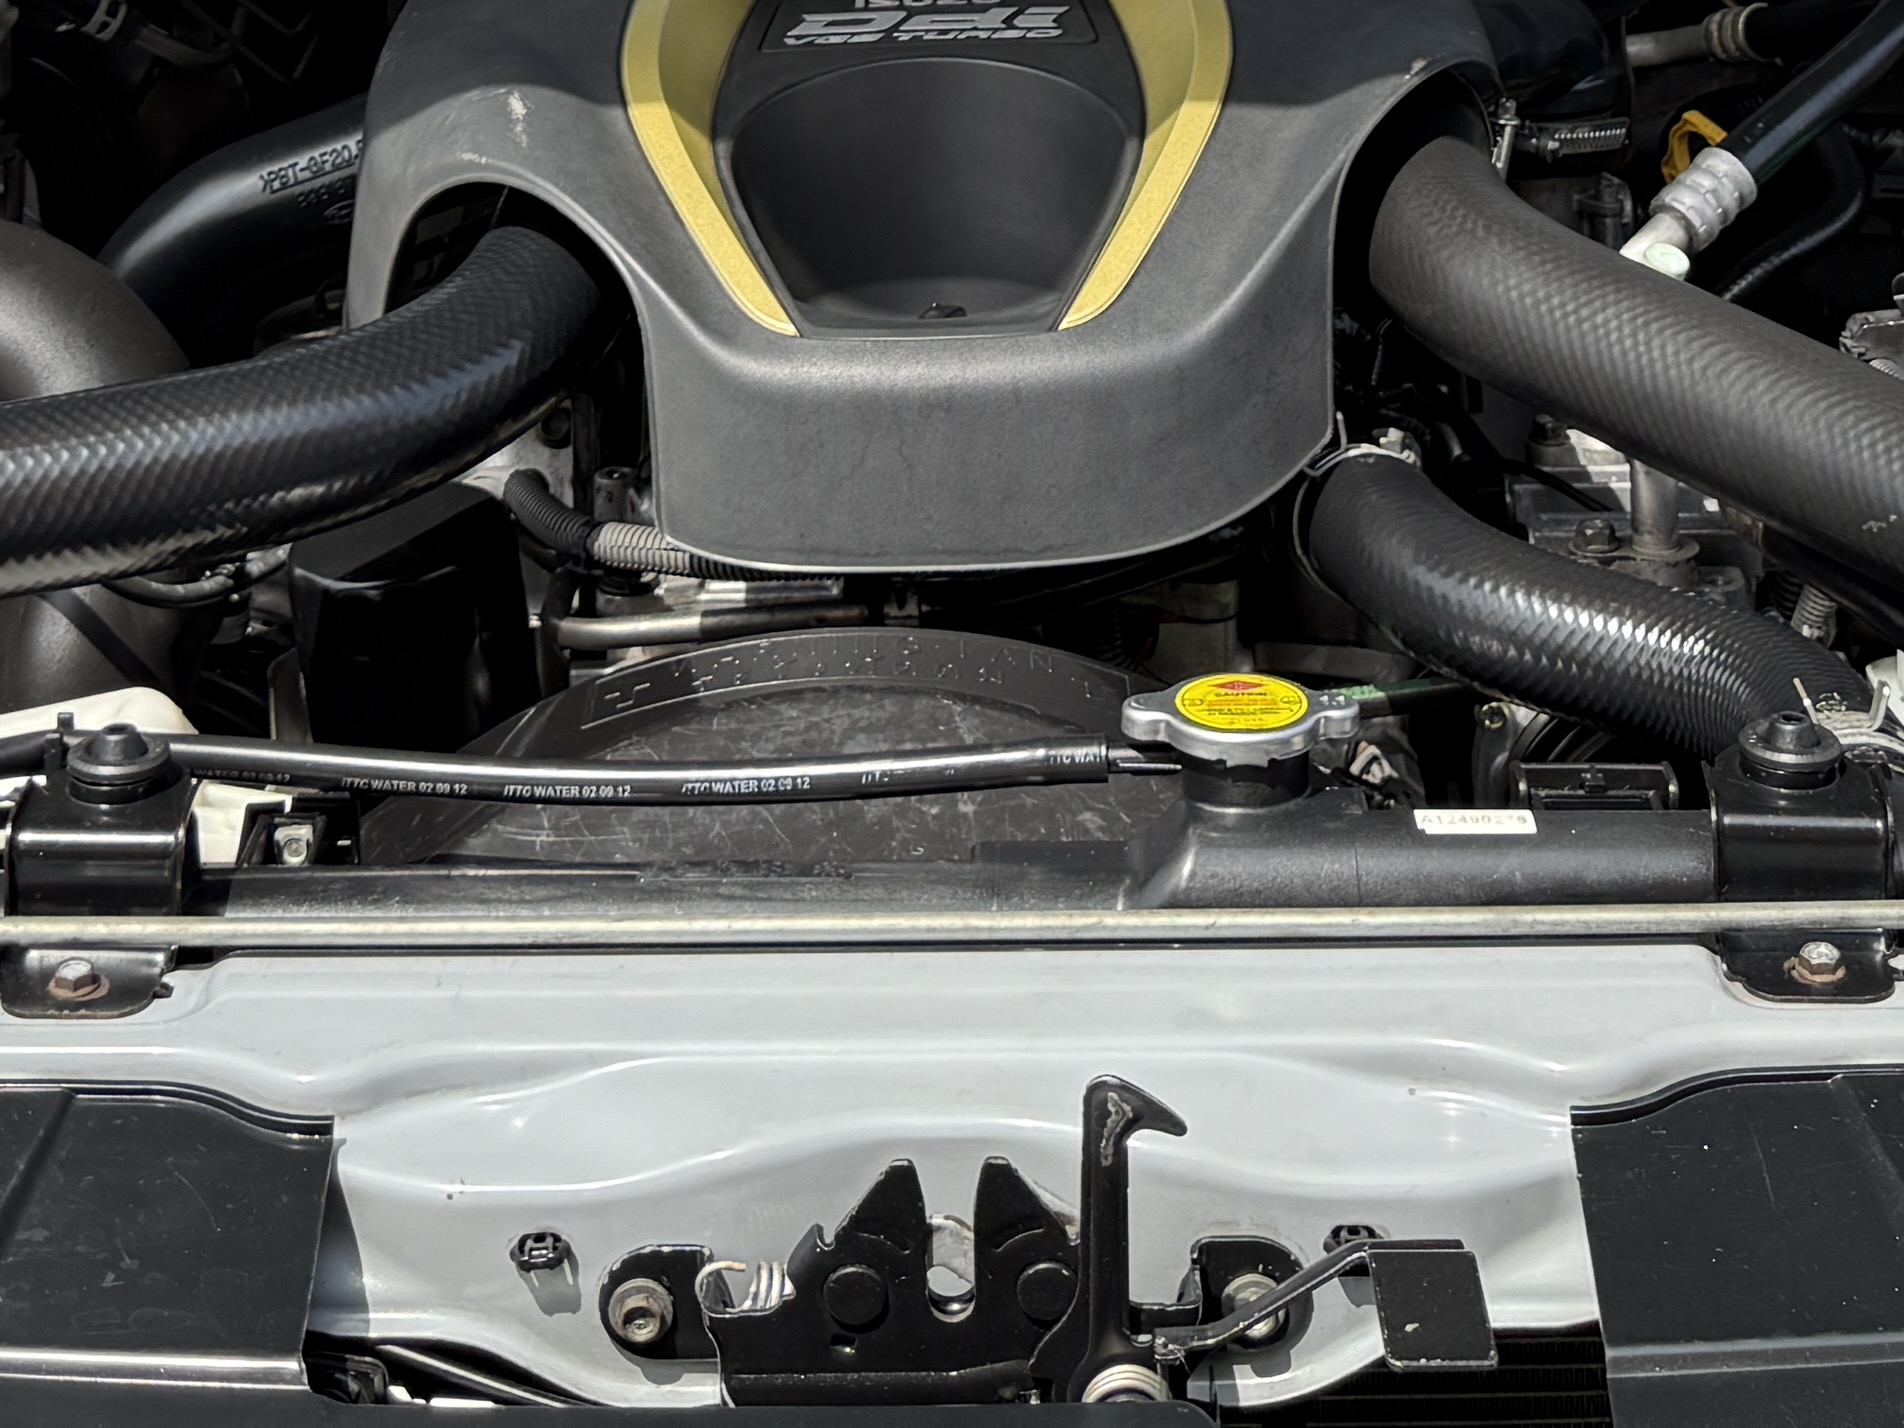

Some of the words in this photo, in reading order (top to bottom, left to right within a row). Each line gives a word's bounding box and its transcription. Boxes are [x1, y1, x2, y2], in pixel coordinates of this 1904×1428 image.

[370, 778, 416, 793] WATER
[533, 784, 580, 799] WATER
[712, 779, 759, 794] WATER
